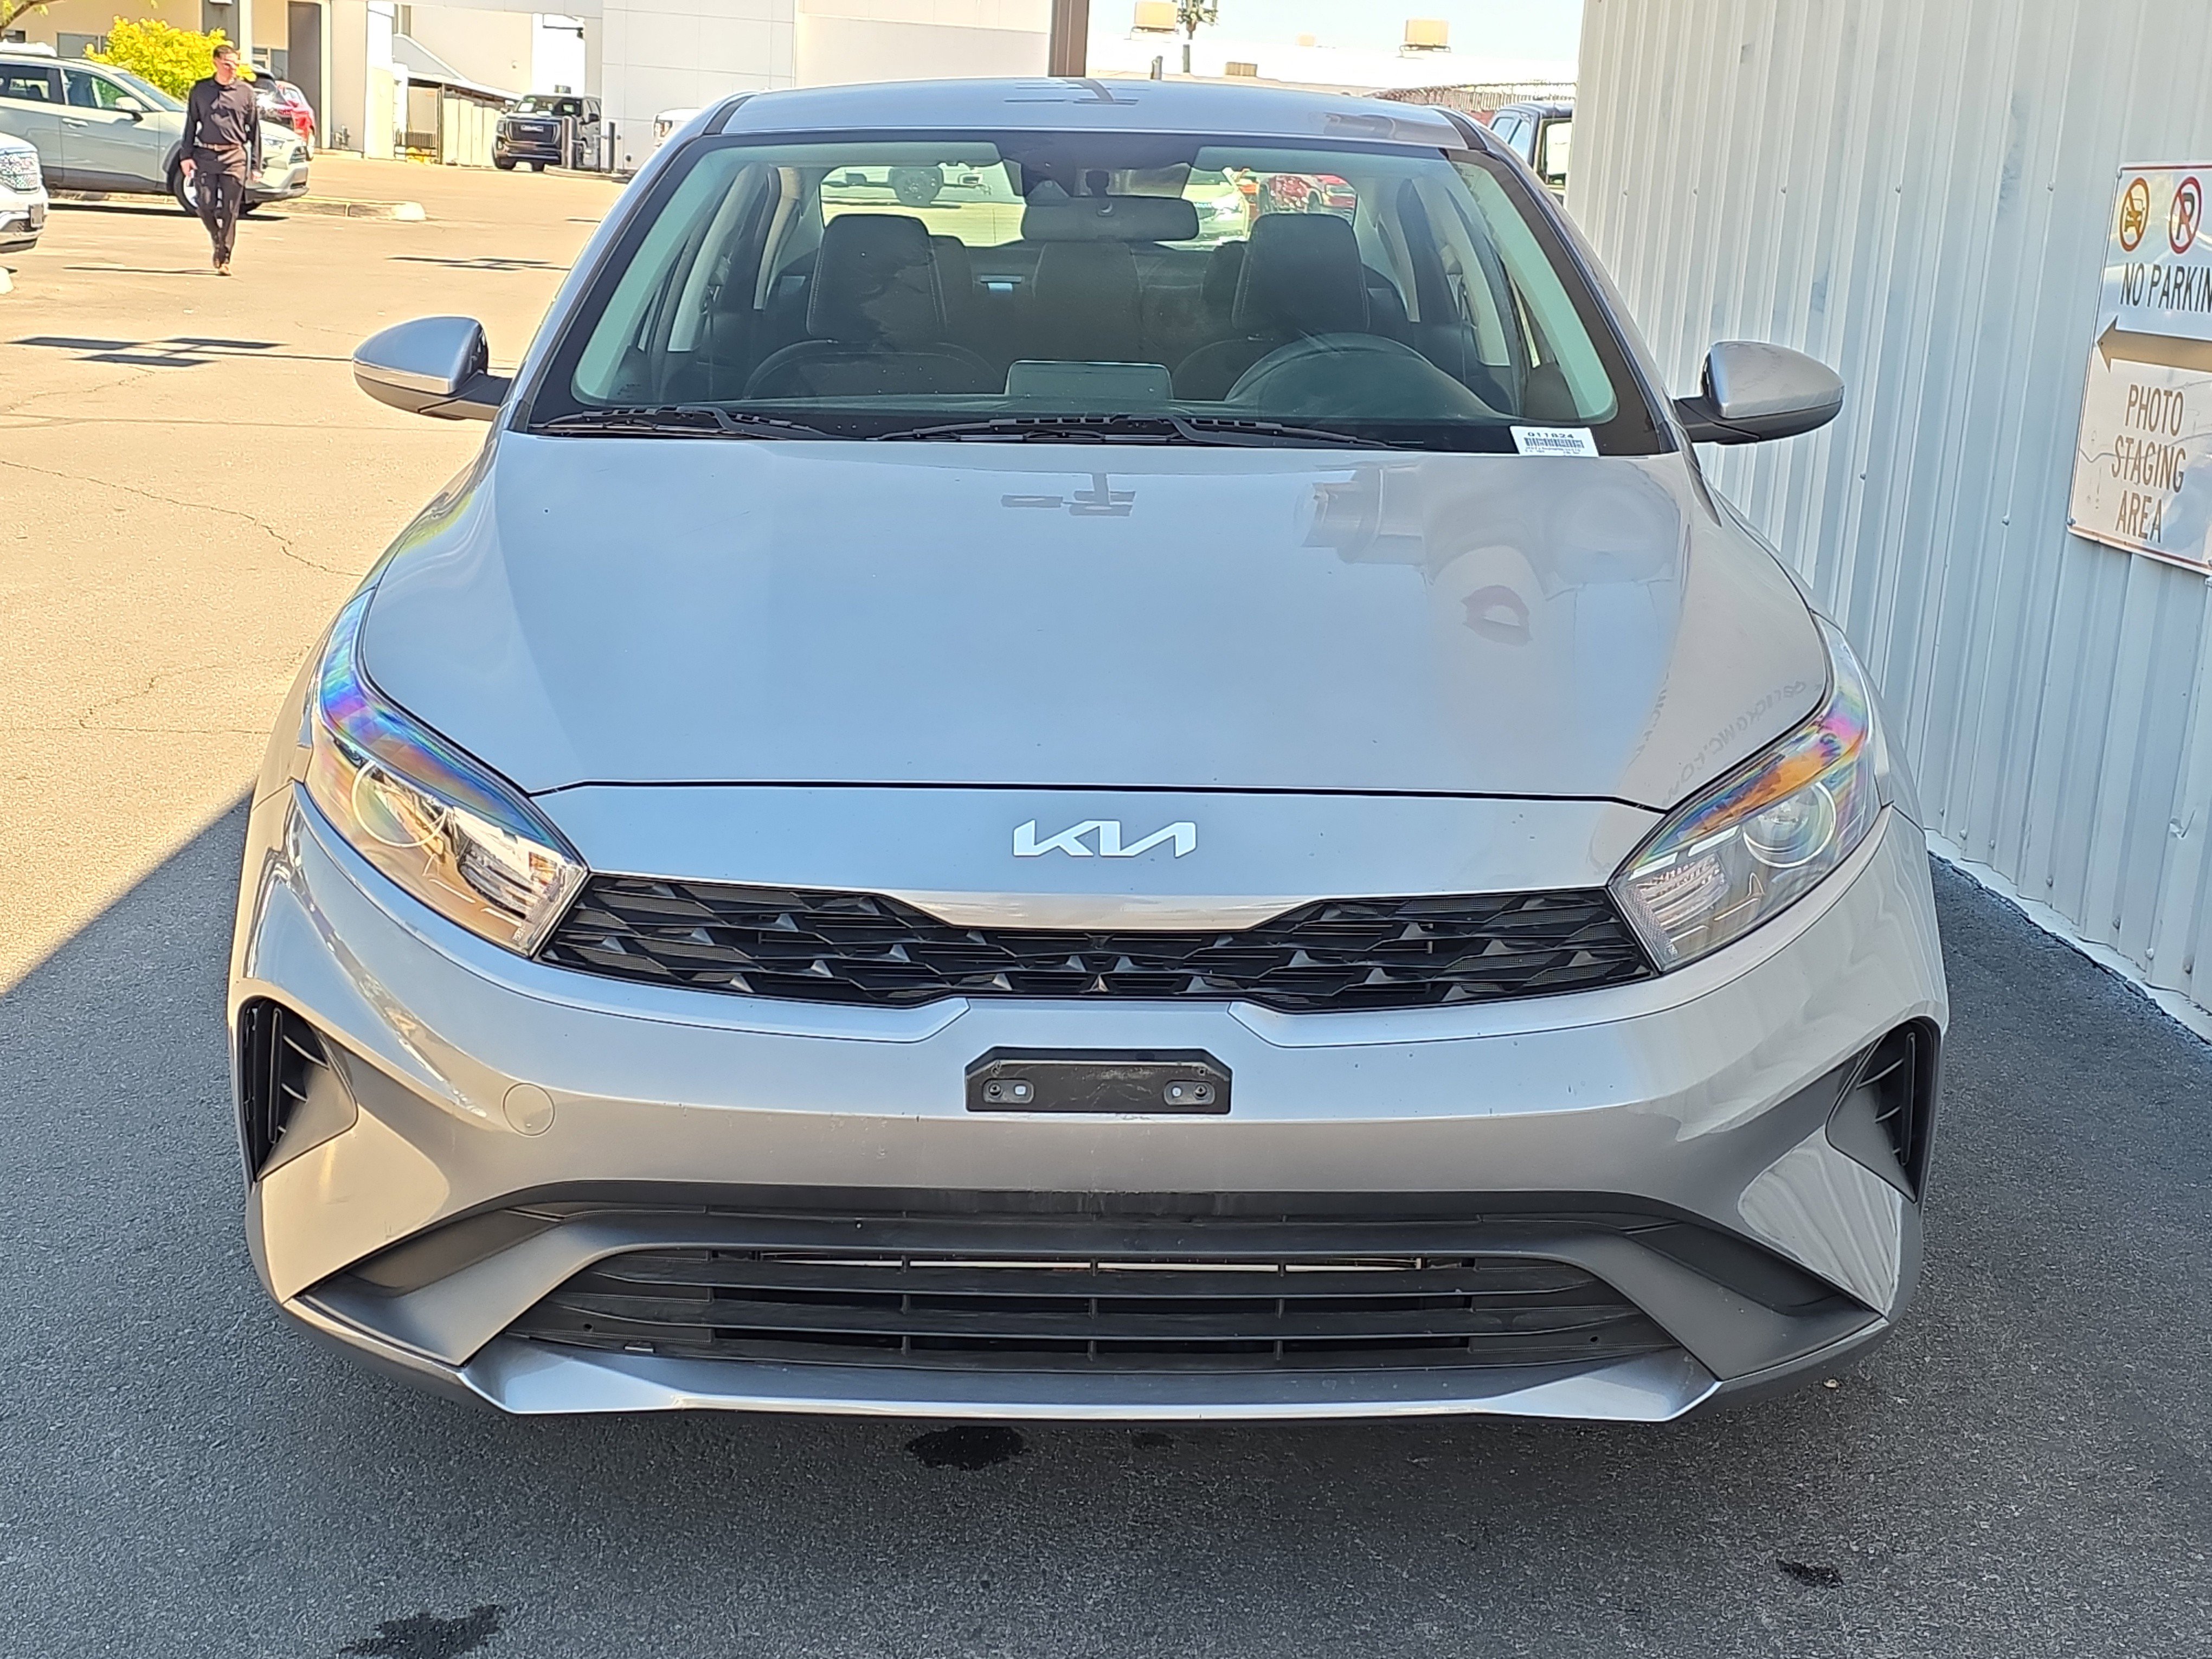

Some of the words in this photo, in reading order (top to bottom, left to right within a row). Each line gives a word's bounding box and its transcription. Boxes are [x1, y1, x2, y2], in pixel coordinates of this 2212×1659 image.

[2120, 262, 2145, 306] NO
[2125, 383, 2184, 437] PHOTO
[2111, 434, 2186, 493] STAGING
[2115, 490, 2162, 543] AREA
[1013, 819, 1197, 859] KIA
